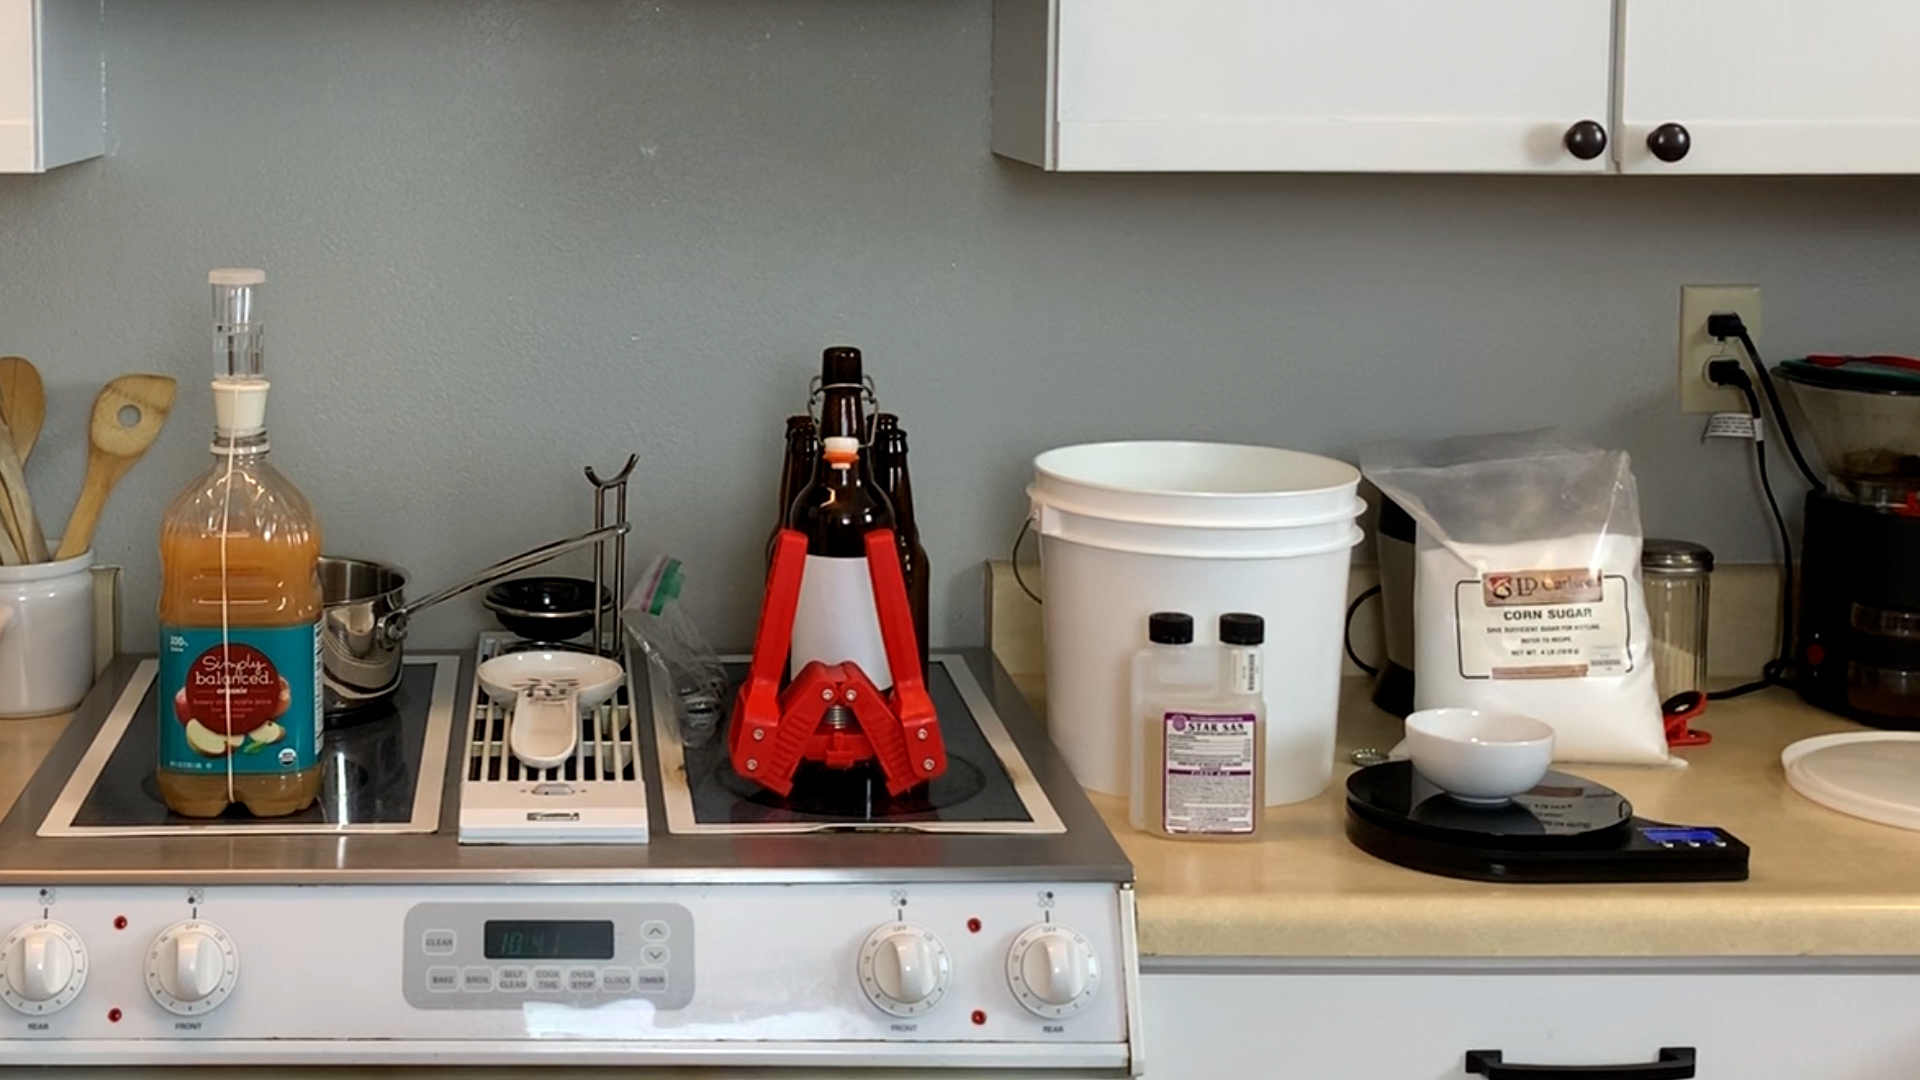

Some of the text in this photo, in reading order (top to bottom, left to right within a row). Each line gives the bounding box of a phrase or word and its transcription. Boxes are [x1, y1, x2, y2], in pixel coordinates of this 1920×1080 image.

[1503, 607, 1593, 621] CORN SUGAR
[202, 653, 268, 676] Simply
[1188, 722, 1218, 732] STAR
[425, 938, 454, 947] CLEAR
[432, 975, 454, 985] BAKE
[499, 980, 528, 990] CLEAN
[572, 980, 594, 990] STOP
[603, 975, 631, 985] CLOCK
[27, 1022, 50, 1031] REAR
[174, 1022, 203, 1031] FRONT
[890, 1023, 918, 1033] FRONT
[1042, 1025, 1065, 1034] REAR
